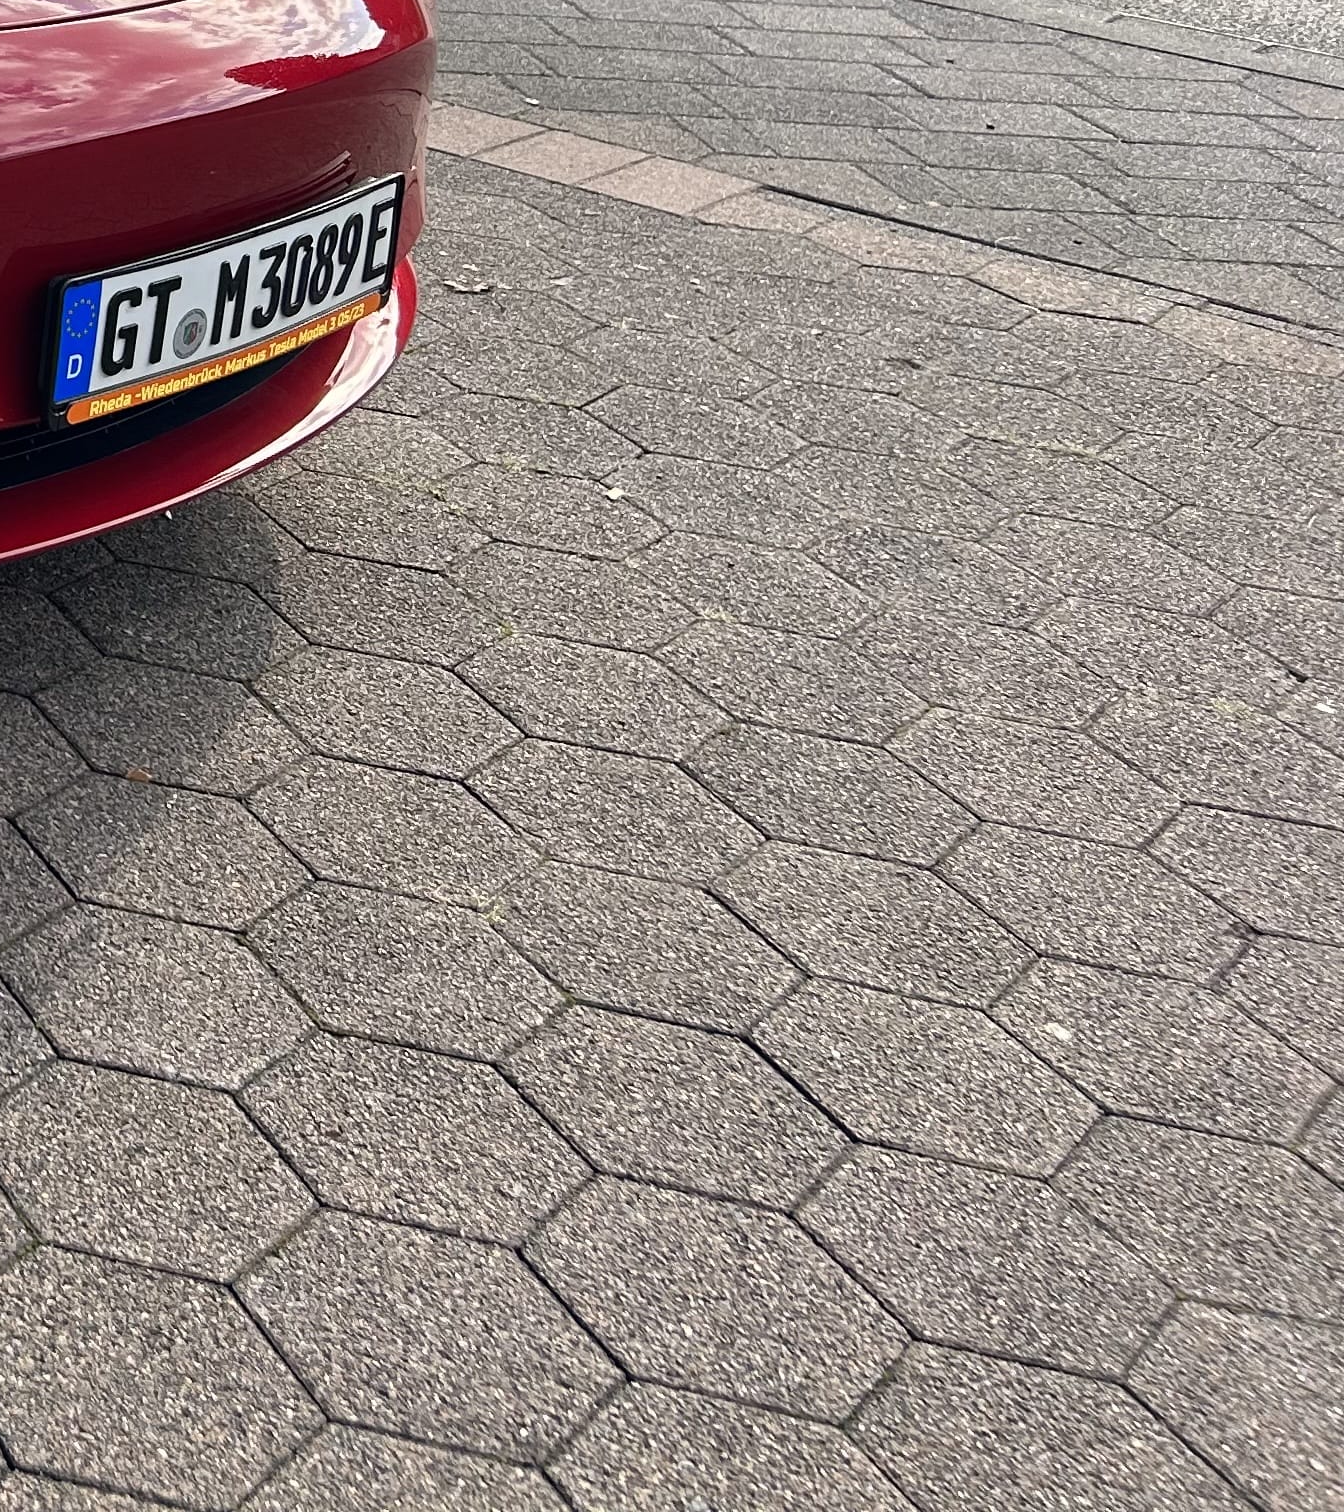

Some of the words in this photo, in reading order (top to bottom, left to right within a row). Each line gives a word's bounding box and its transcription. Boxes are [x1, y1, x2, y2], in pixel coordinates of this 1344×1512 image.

[66, 353, 82, 380] D
[89, 392, 133, 417] Rheda
[224, 349, 267, 374] Markus
[269, 336, 297, 357] Tesla
[298, 320, 328, 345] Model
[328, 316, 337, 330] 3
[100, 275, 183, 377] GT
